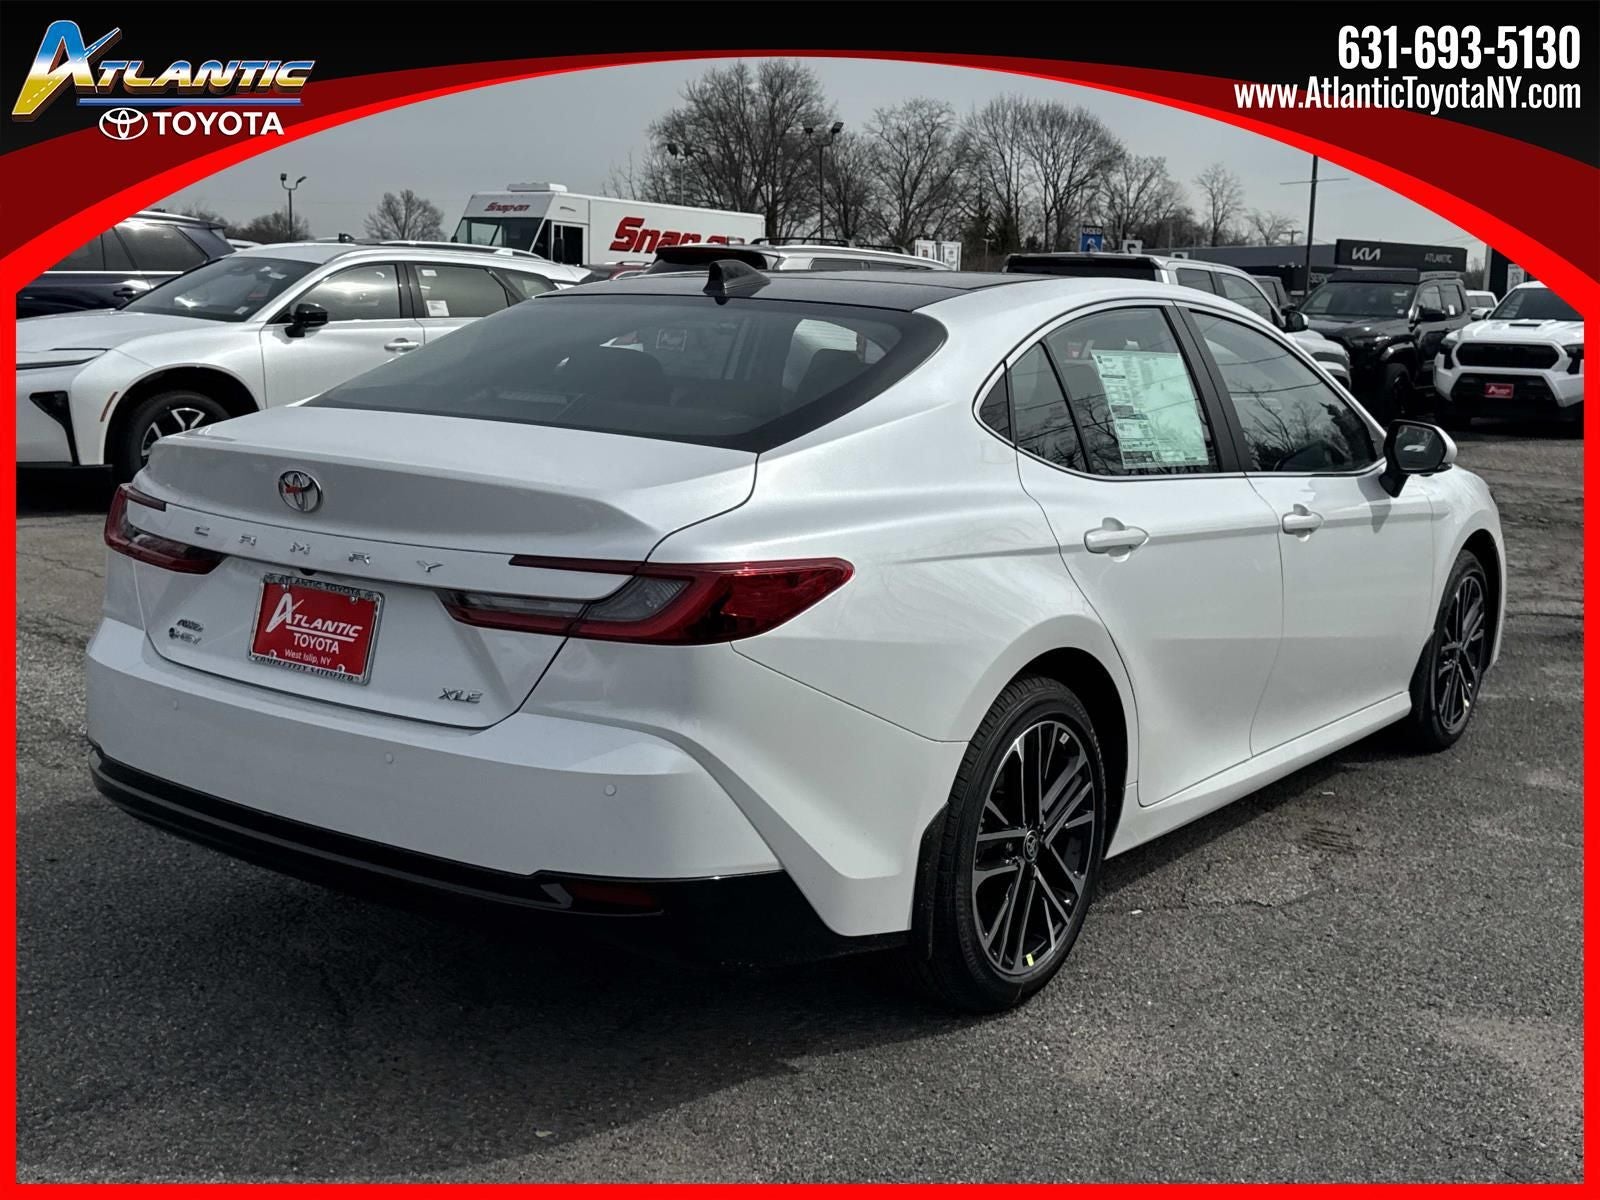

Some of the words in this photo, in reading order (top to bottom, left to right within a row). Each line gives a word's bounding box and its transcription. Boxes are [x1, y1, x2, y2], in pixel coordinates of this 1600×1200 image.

[484, 201, 530, 213] Snap-on
[1351, 247, 1382, 261] KIA
[193, 525, 443, 573] CAMRY
[325, 583, 361, 597] TOYOTA
[265, 592, 363, 637] ATLANTIC
[293, 632, 340, 655] TOYOTA
[284, 649, 302, 659] West
[303, 652, 319, 665] Islip,
[320, 656, 332, 665] NY
[438, 687, 483, 704] XLE
